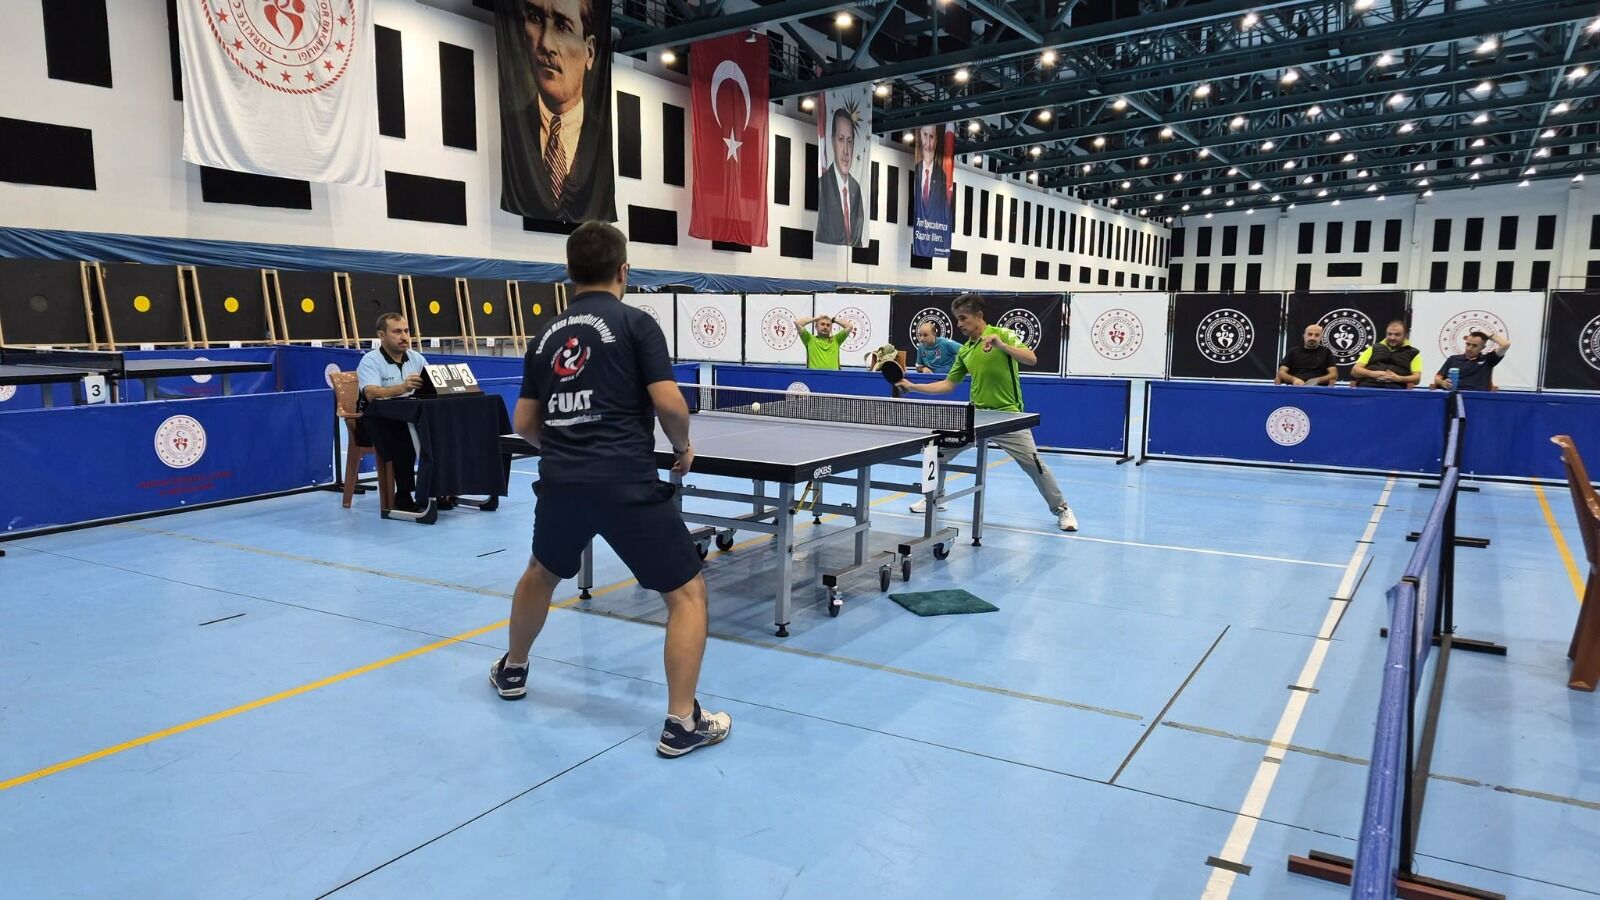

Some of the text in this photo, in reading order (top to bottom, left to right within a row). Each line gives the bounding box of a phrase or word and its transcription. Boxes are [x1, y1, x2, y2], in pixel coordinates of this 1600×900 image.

[431, 369, 443, 386] 6
[441, 362, 450, 380] 0
[461, 368, 474, 385] 3
[91, 384, 101, 396] 3
[548, 389, 593, 413] FUAT
[927, 460, 936, 481] 2
